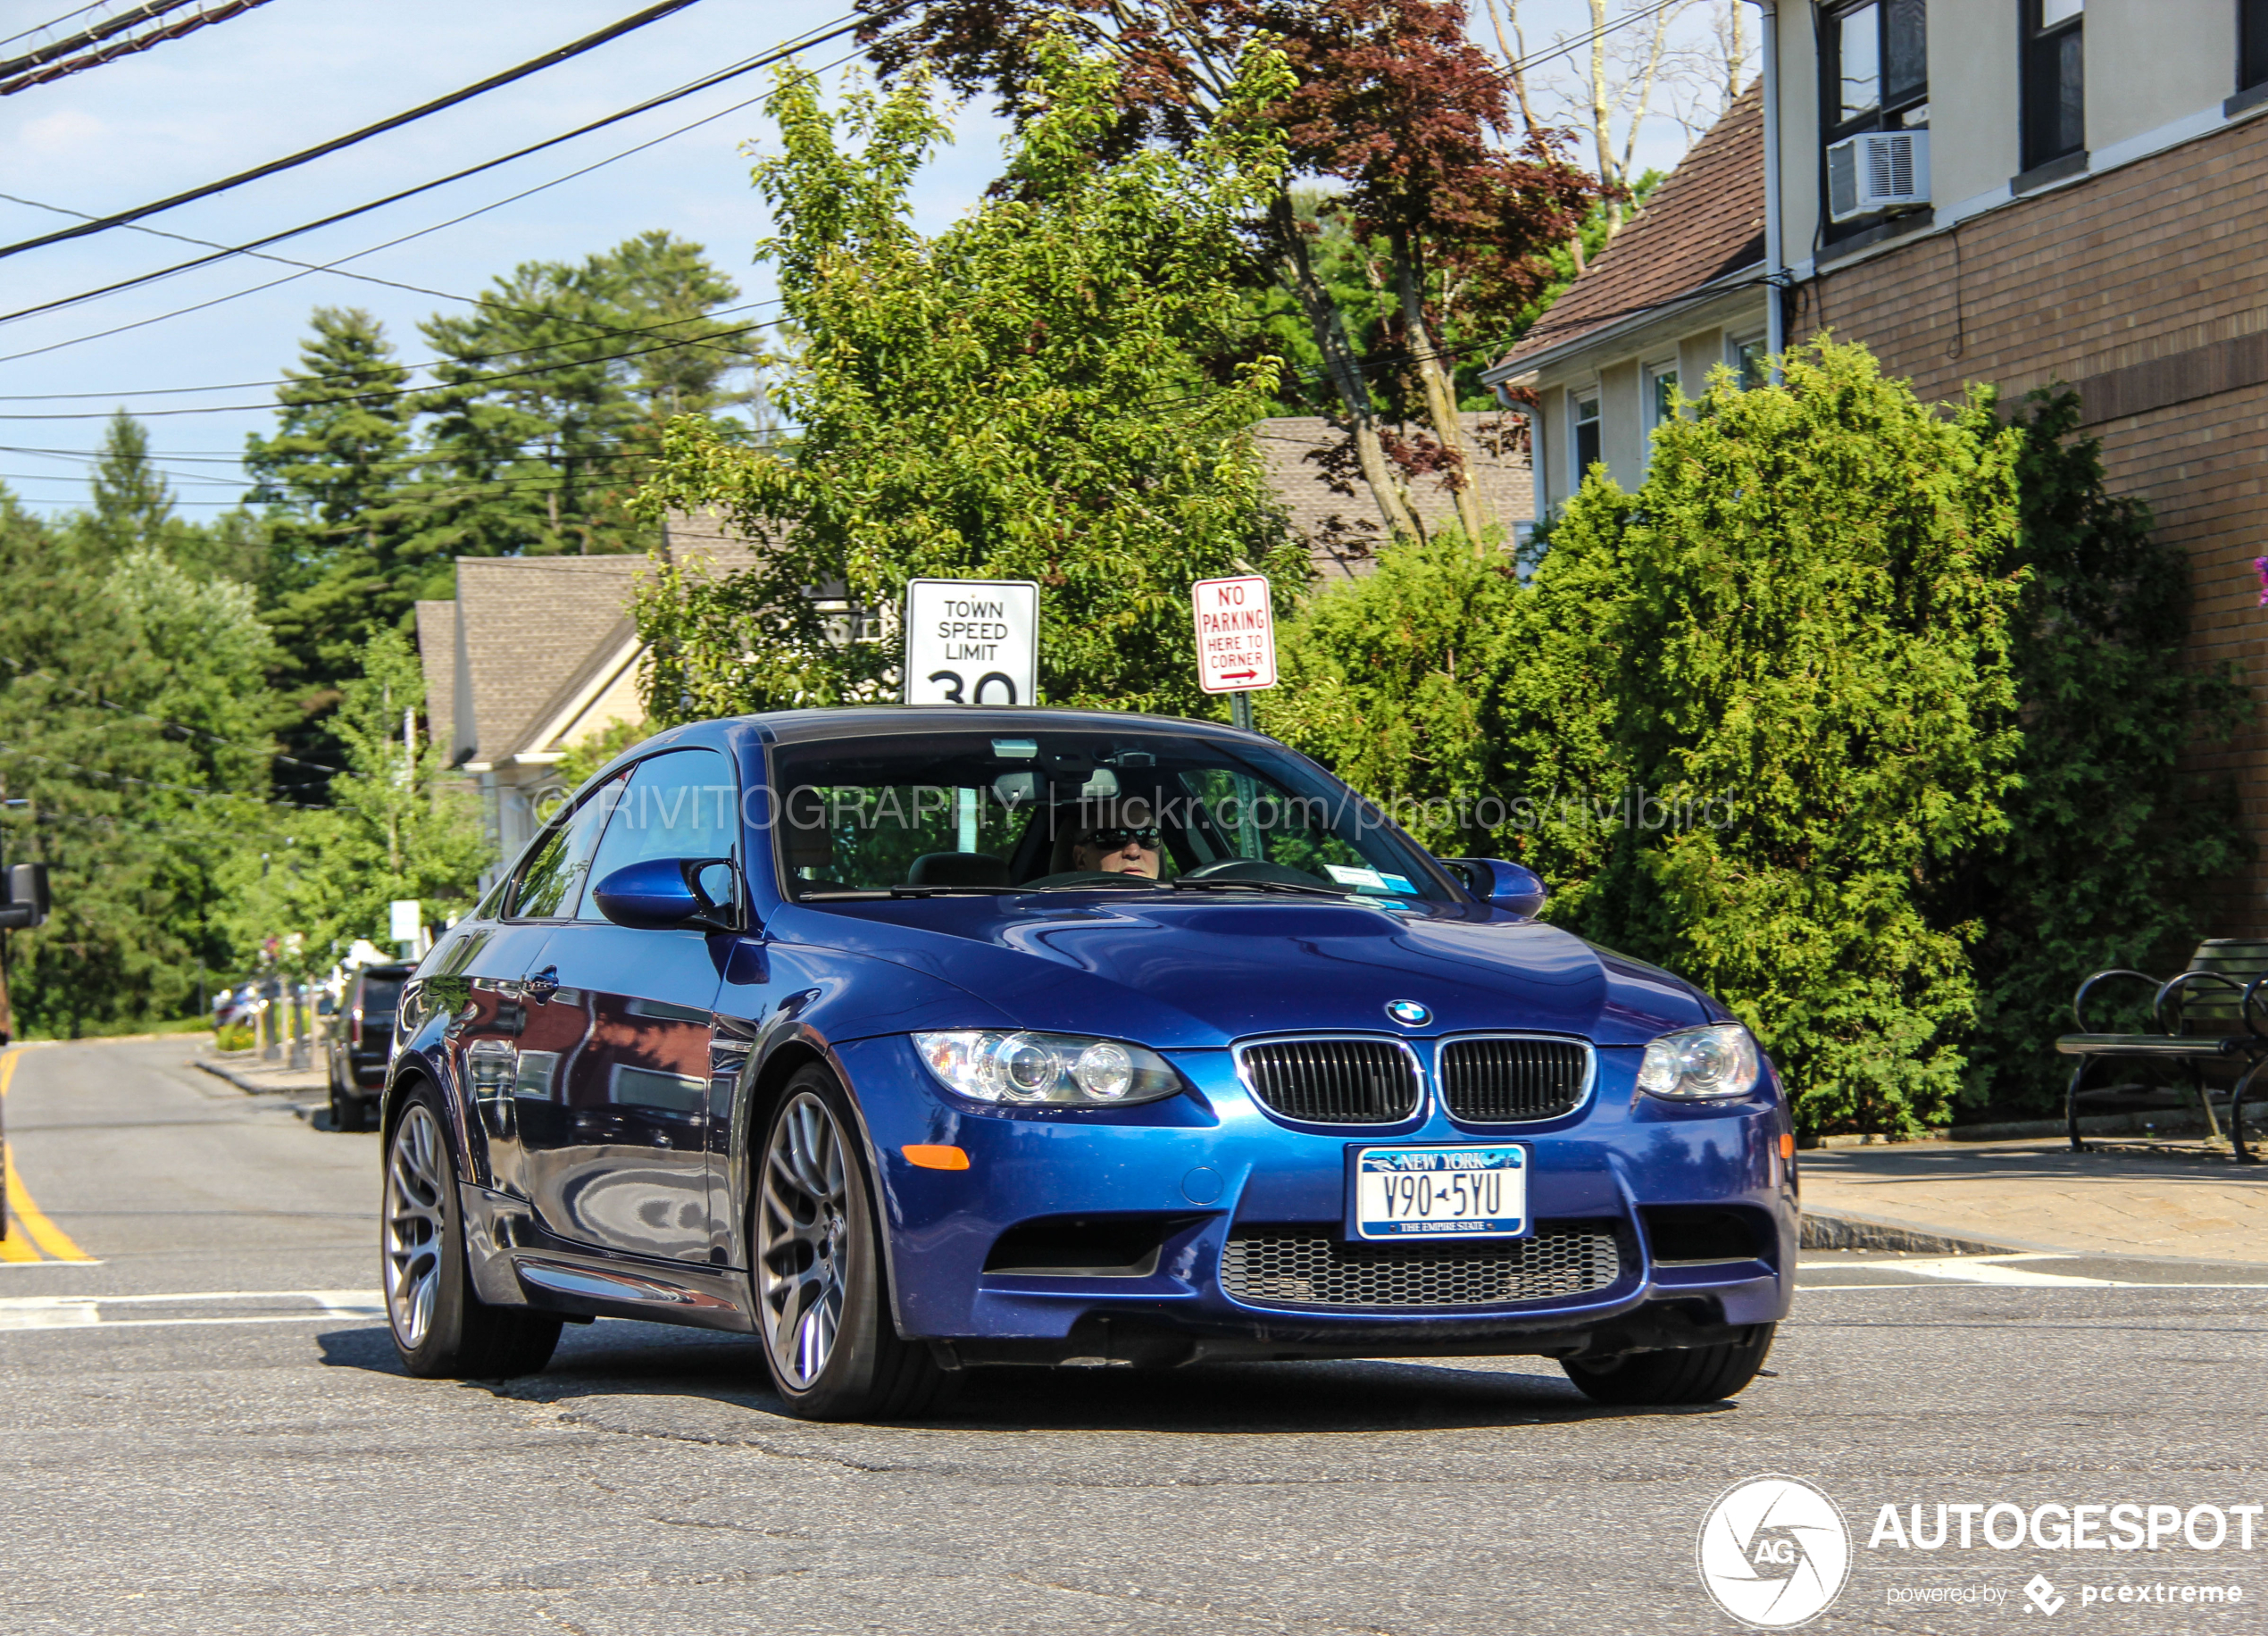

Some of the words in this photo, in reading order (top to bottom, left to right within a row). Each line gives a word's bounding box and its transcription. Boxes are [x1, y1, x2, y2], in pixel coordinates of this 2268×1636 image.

[1218, 586, 1245, 606] NO
[944, 600, 1004, 618] TOWN
[1203, 609, 1264, 633] PARKING
[938, 622, 1008, 639] SPEED
[946, 643, 998, 661] LIMIT
[1207, 636, 1242, 652] HERE
[1247, 635, 1263, 648] TO
[1211, 652, 1263, 669] CORNER
[927, 670, 1018, 705] 30
[1400, 1153, 1439, 1171] NEW
[1441, 1152, 1486, 1170] YORK
[1400, 1223, 1421, 1232] THE
[1422, 1222, 1457, 1231] EMPIRE
[1457, 1221, 1485, 1231] STATE
